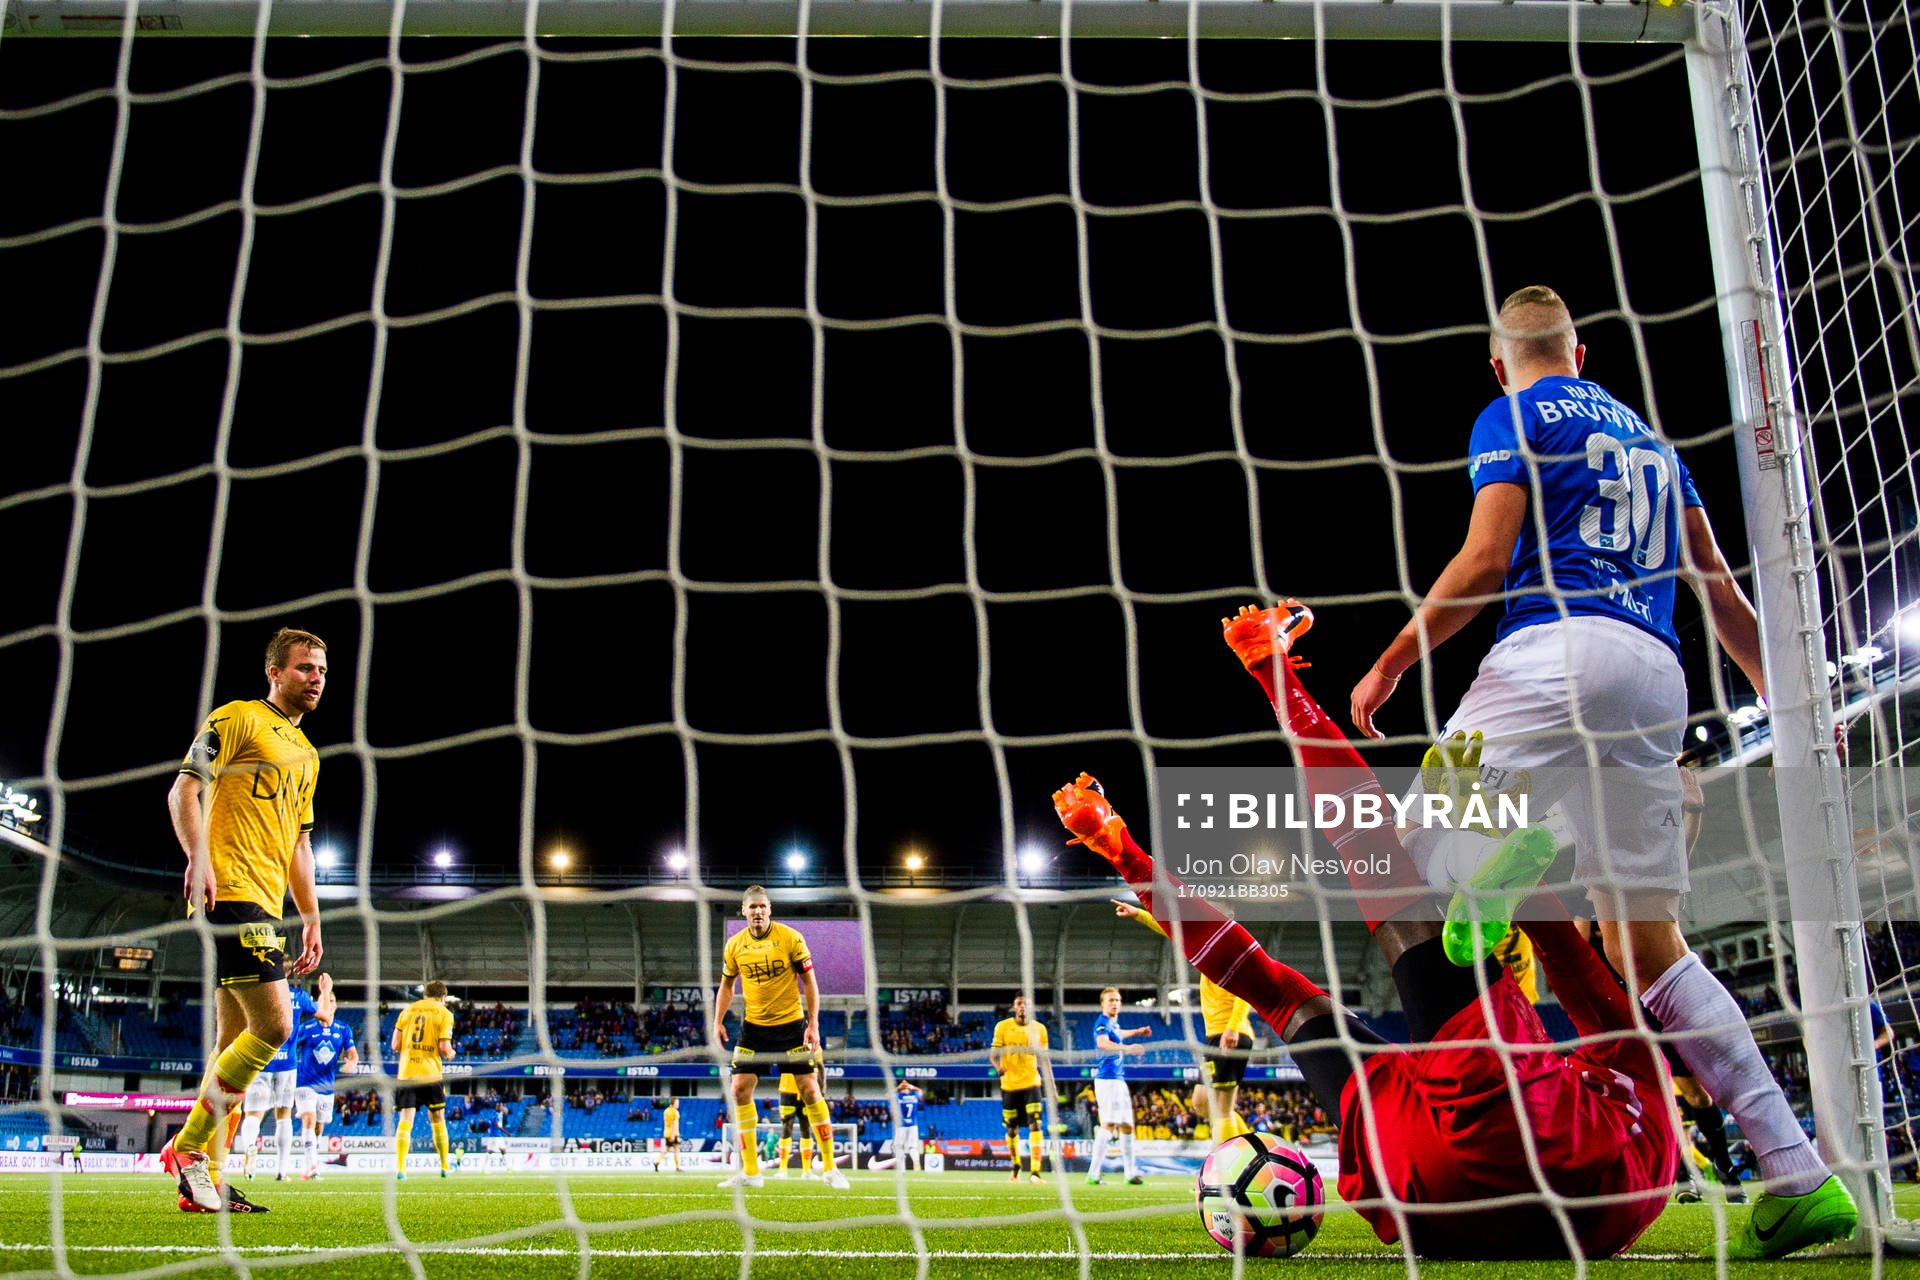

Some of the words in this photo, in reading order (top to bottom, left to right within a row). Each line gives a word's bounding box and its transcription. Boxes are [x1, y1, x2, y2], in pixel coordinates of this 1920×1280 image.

[1579, 431, 1669, 570] 30
[740, 955, 786, 984] DNB
[412, 1015, 425, 1043] 3
[70, 1056, 100, 1068] ISTAD
[160, 1061, 193, 1072] ISTAD
[352, 1064, 377, 1075] STAD
[627, 1066, 659, 1077] ISTAD
[905, 1068, 938, 1078] ISTAD
[905, 1103, 914, 1118] 7
[343, 1141, 387, 1150] GLAMOX
[358, 1158, 385, 1168] CUT
[587, 1157, 633, 1168] BREAK
